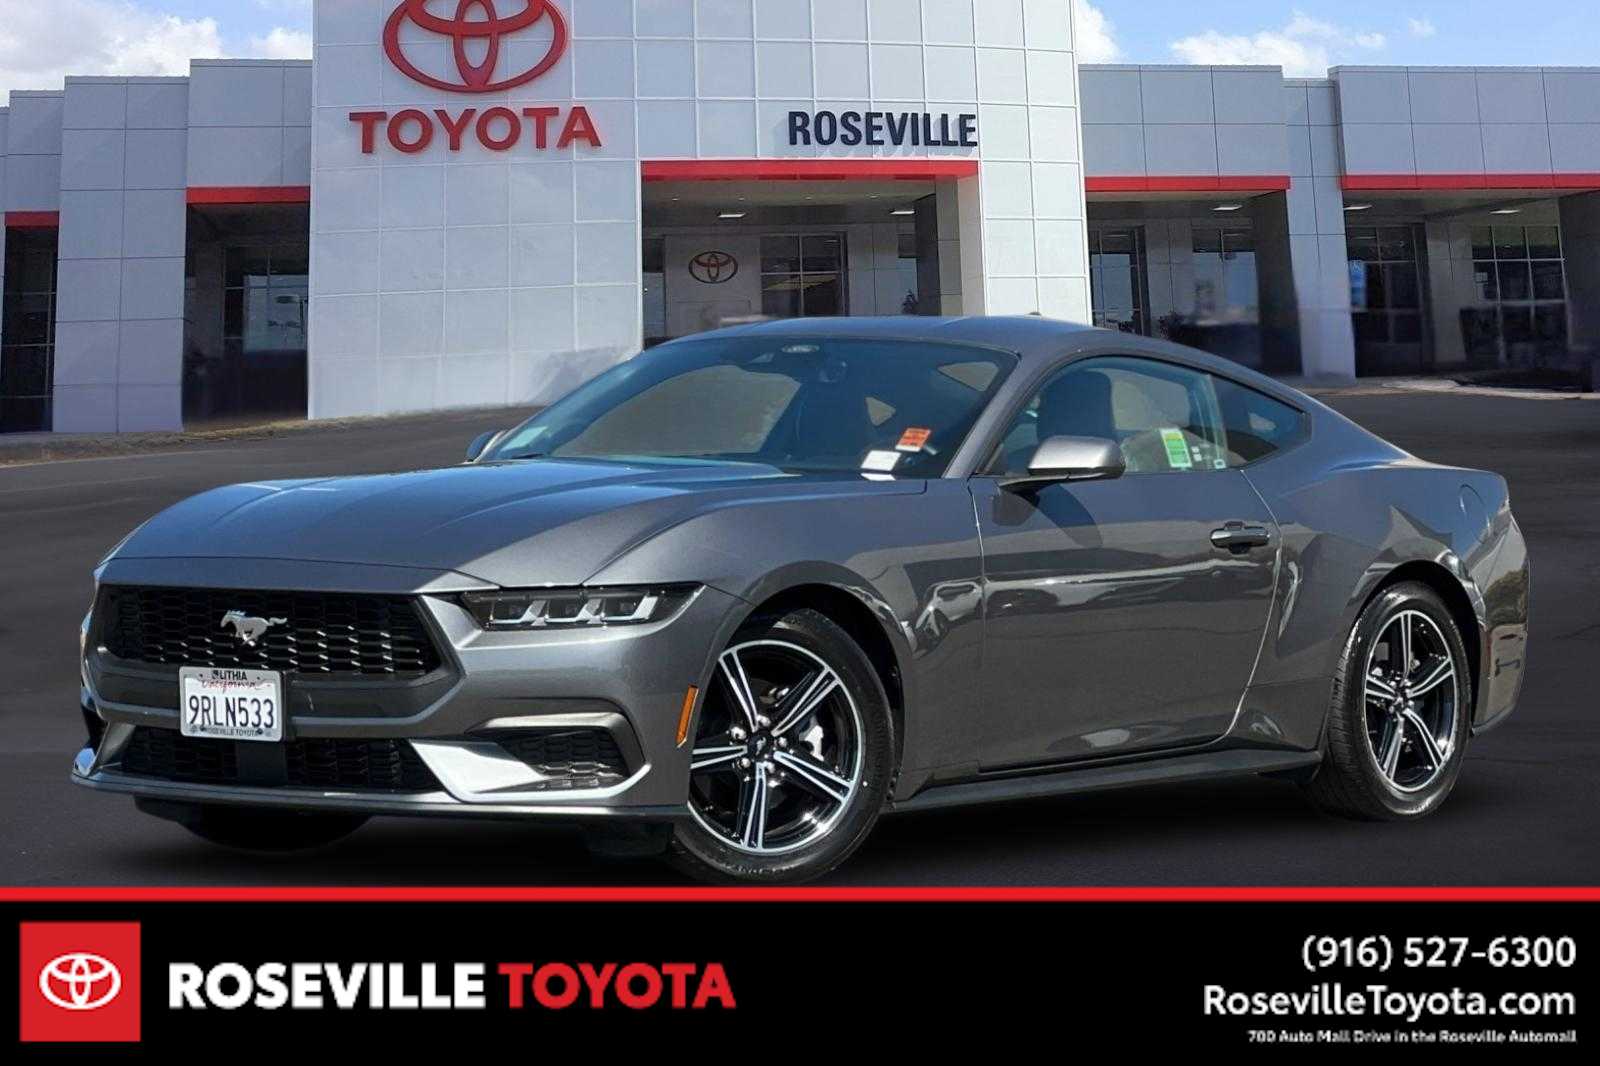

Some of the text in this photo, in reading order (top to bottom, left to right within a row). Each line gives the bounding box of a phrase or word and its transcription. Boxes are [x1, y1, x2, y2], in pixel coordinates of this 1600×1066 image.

[349, 106, 602, 153] TOYOTA
[788, 110, 979, 147] ROSEVILLE
[220, 670, 248, 681] LITHIA
[189, 695, 275, 729] 9RLN533
